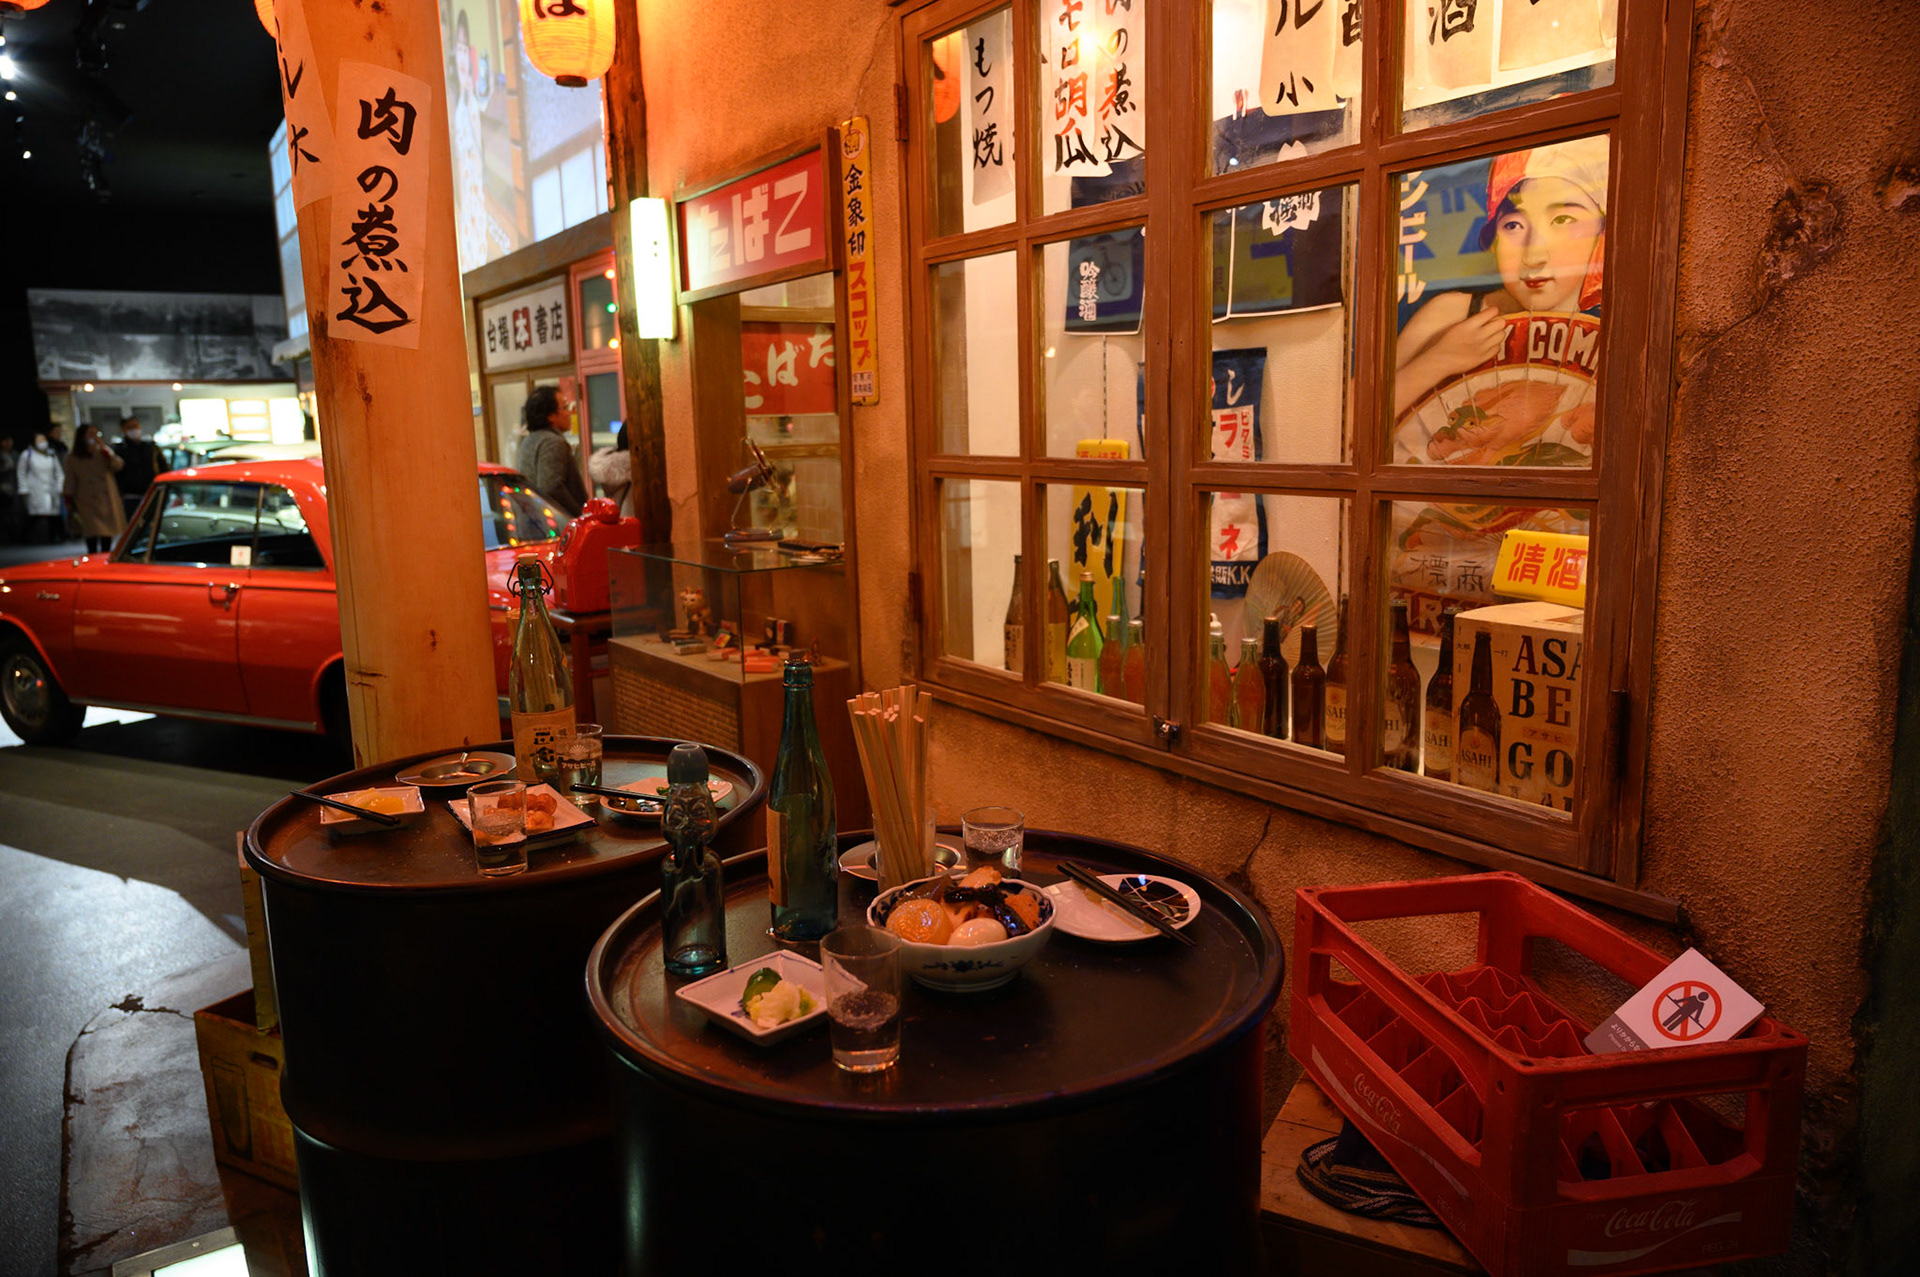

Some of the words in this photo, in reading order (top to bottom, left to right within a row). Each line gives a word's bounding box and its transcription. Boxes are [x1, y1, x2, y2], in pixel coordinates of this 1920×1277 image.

[973, 37, 1003, 170] もつ焼
[337, 86, 417, 334] 肉の煮込
[694, 170, 812, 274] たばこ
[1528, 320, 1600, 370] COM
[1508, 542, 1588, 591] 清酒
